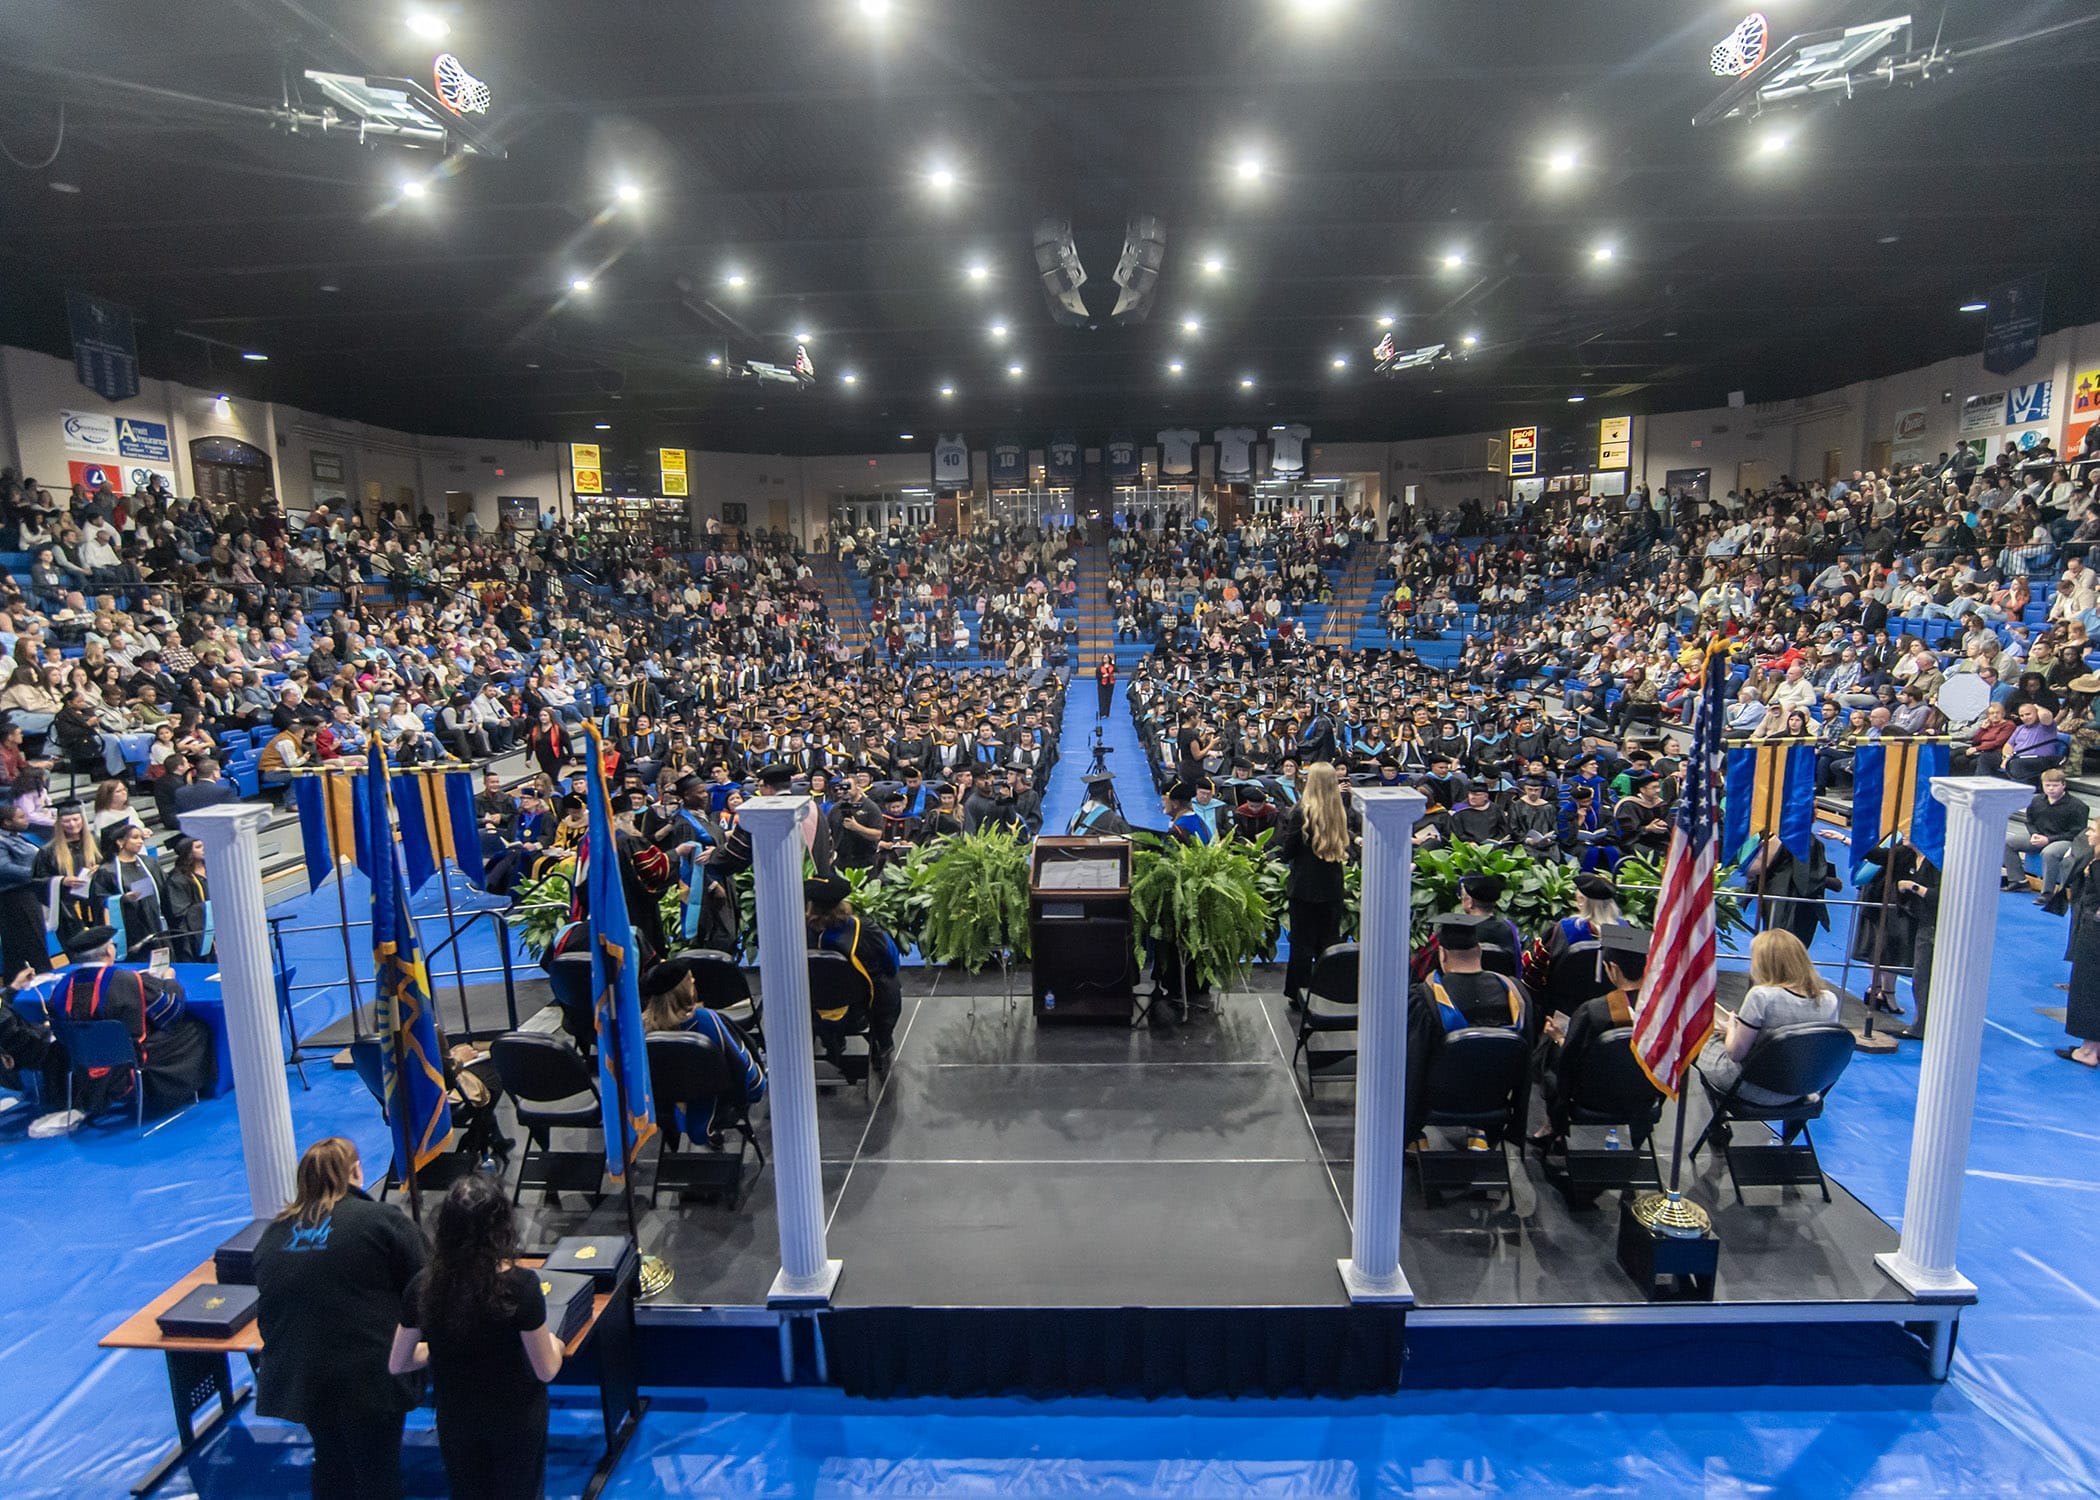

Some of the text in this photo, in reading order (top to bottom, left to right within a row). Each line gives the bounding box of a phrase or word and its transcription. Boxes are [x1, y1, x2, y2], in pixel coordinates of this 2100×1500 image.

[943, 453, 960, 466] 40
[1000, 454, 1015, 467] 10
[1055, 452, 1073, 466] 34
[1112, 450, 1130, 464] 30
